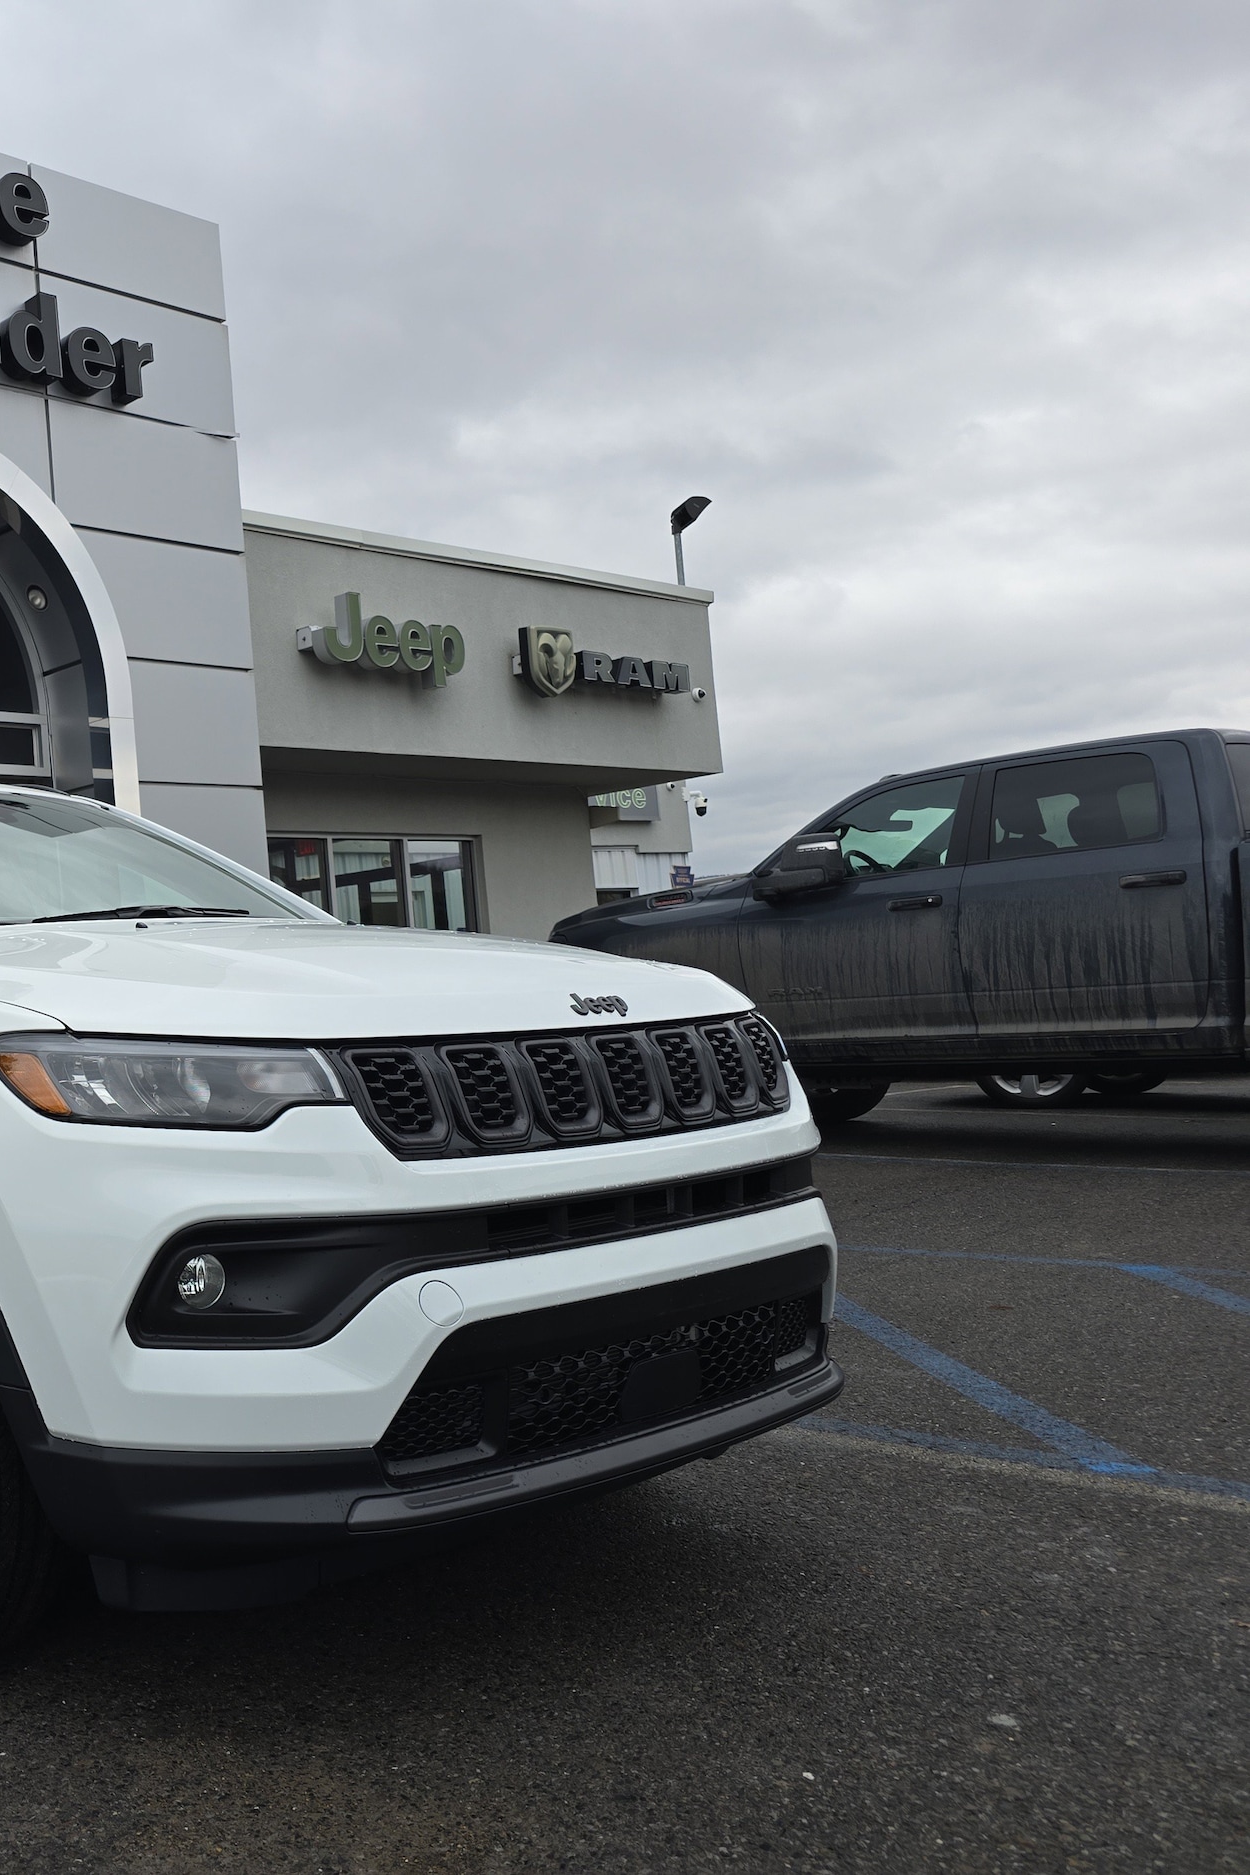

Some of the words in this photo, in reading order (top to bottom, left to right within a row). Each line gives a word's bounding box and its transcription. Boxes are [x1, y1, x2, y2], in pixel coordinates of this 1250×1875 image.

[313, 592, 465, 688] Jeep
[576, 650, 691, 694] RAM
[569, 993, 629, 1017] Jeep
